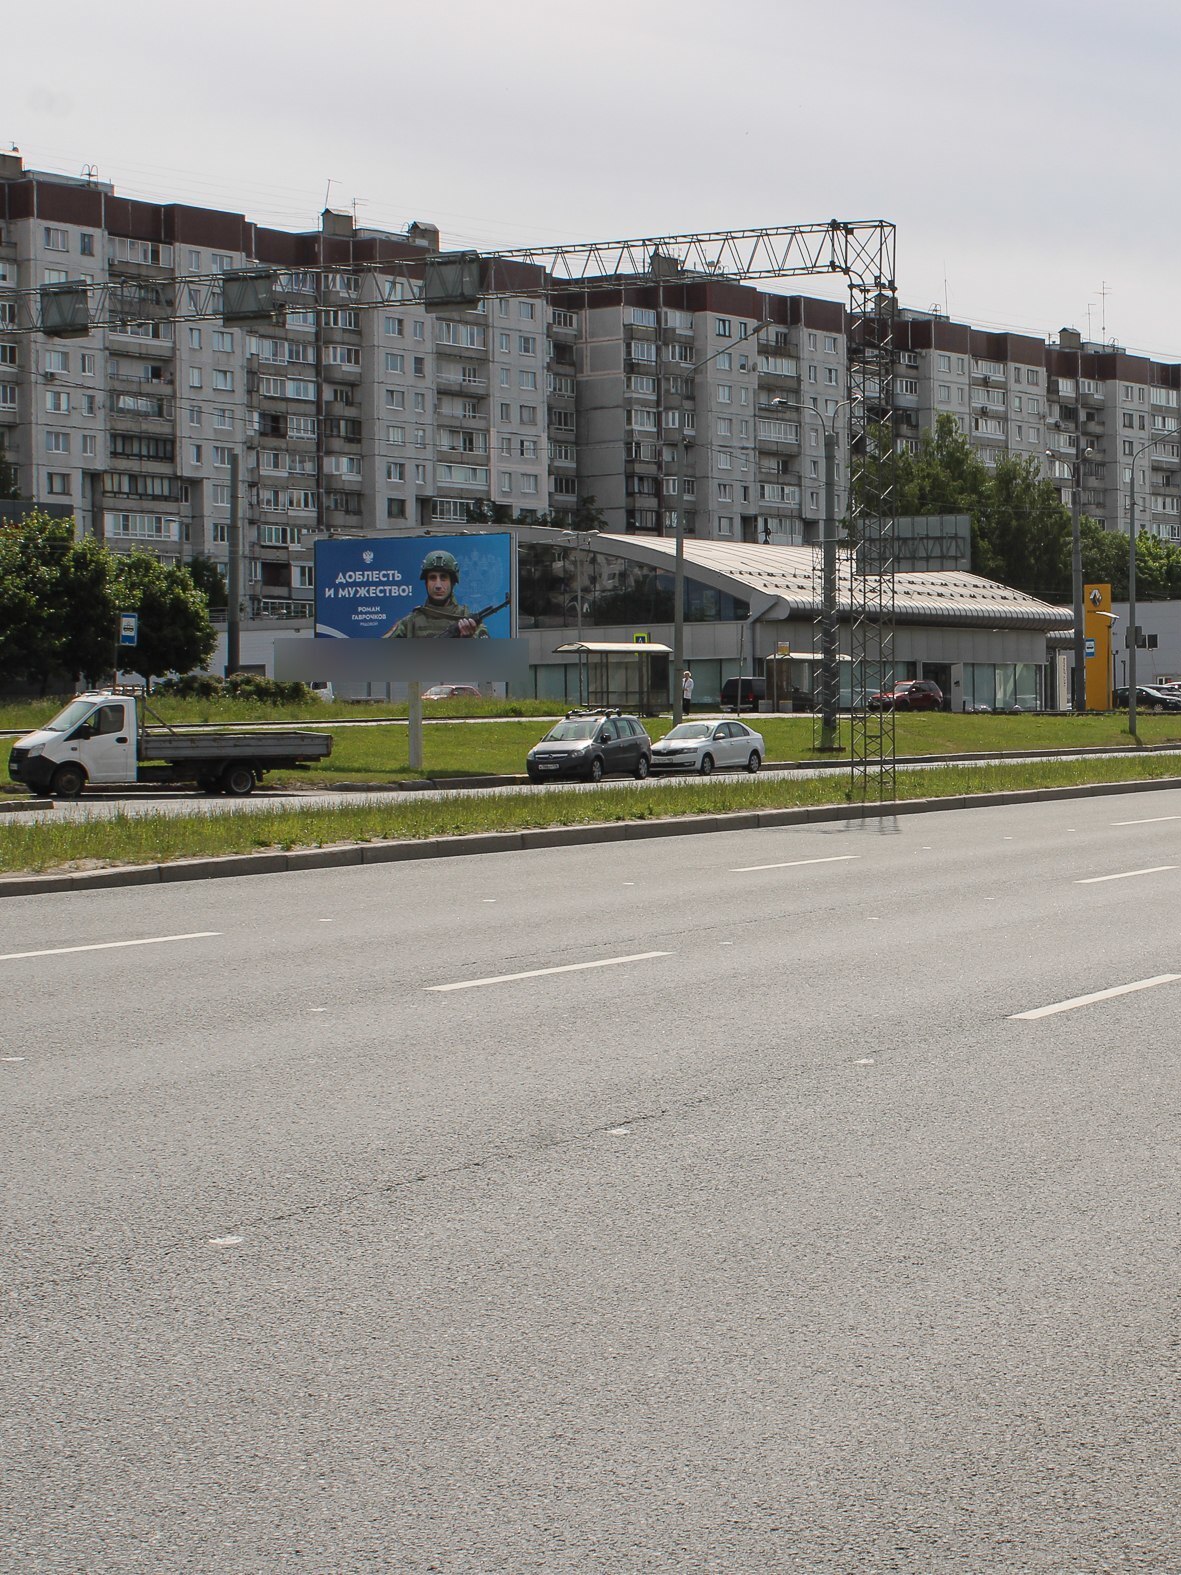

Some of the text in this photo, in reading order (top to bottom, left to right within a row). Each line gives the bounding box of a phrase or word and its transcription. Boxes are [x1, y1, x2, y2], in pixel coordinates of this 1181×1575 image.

[336, 571, 402, 584] ДОБЛЕСТЬ
[325, 585, 413, 598] И МУЖЕСТВО!
